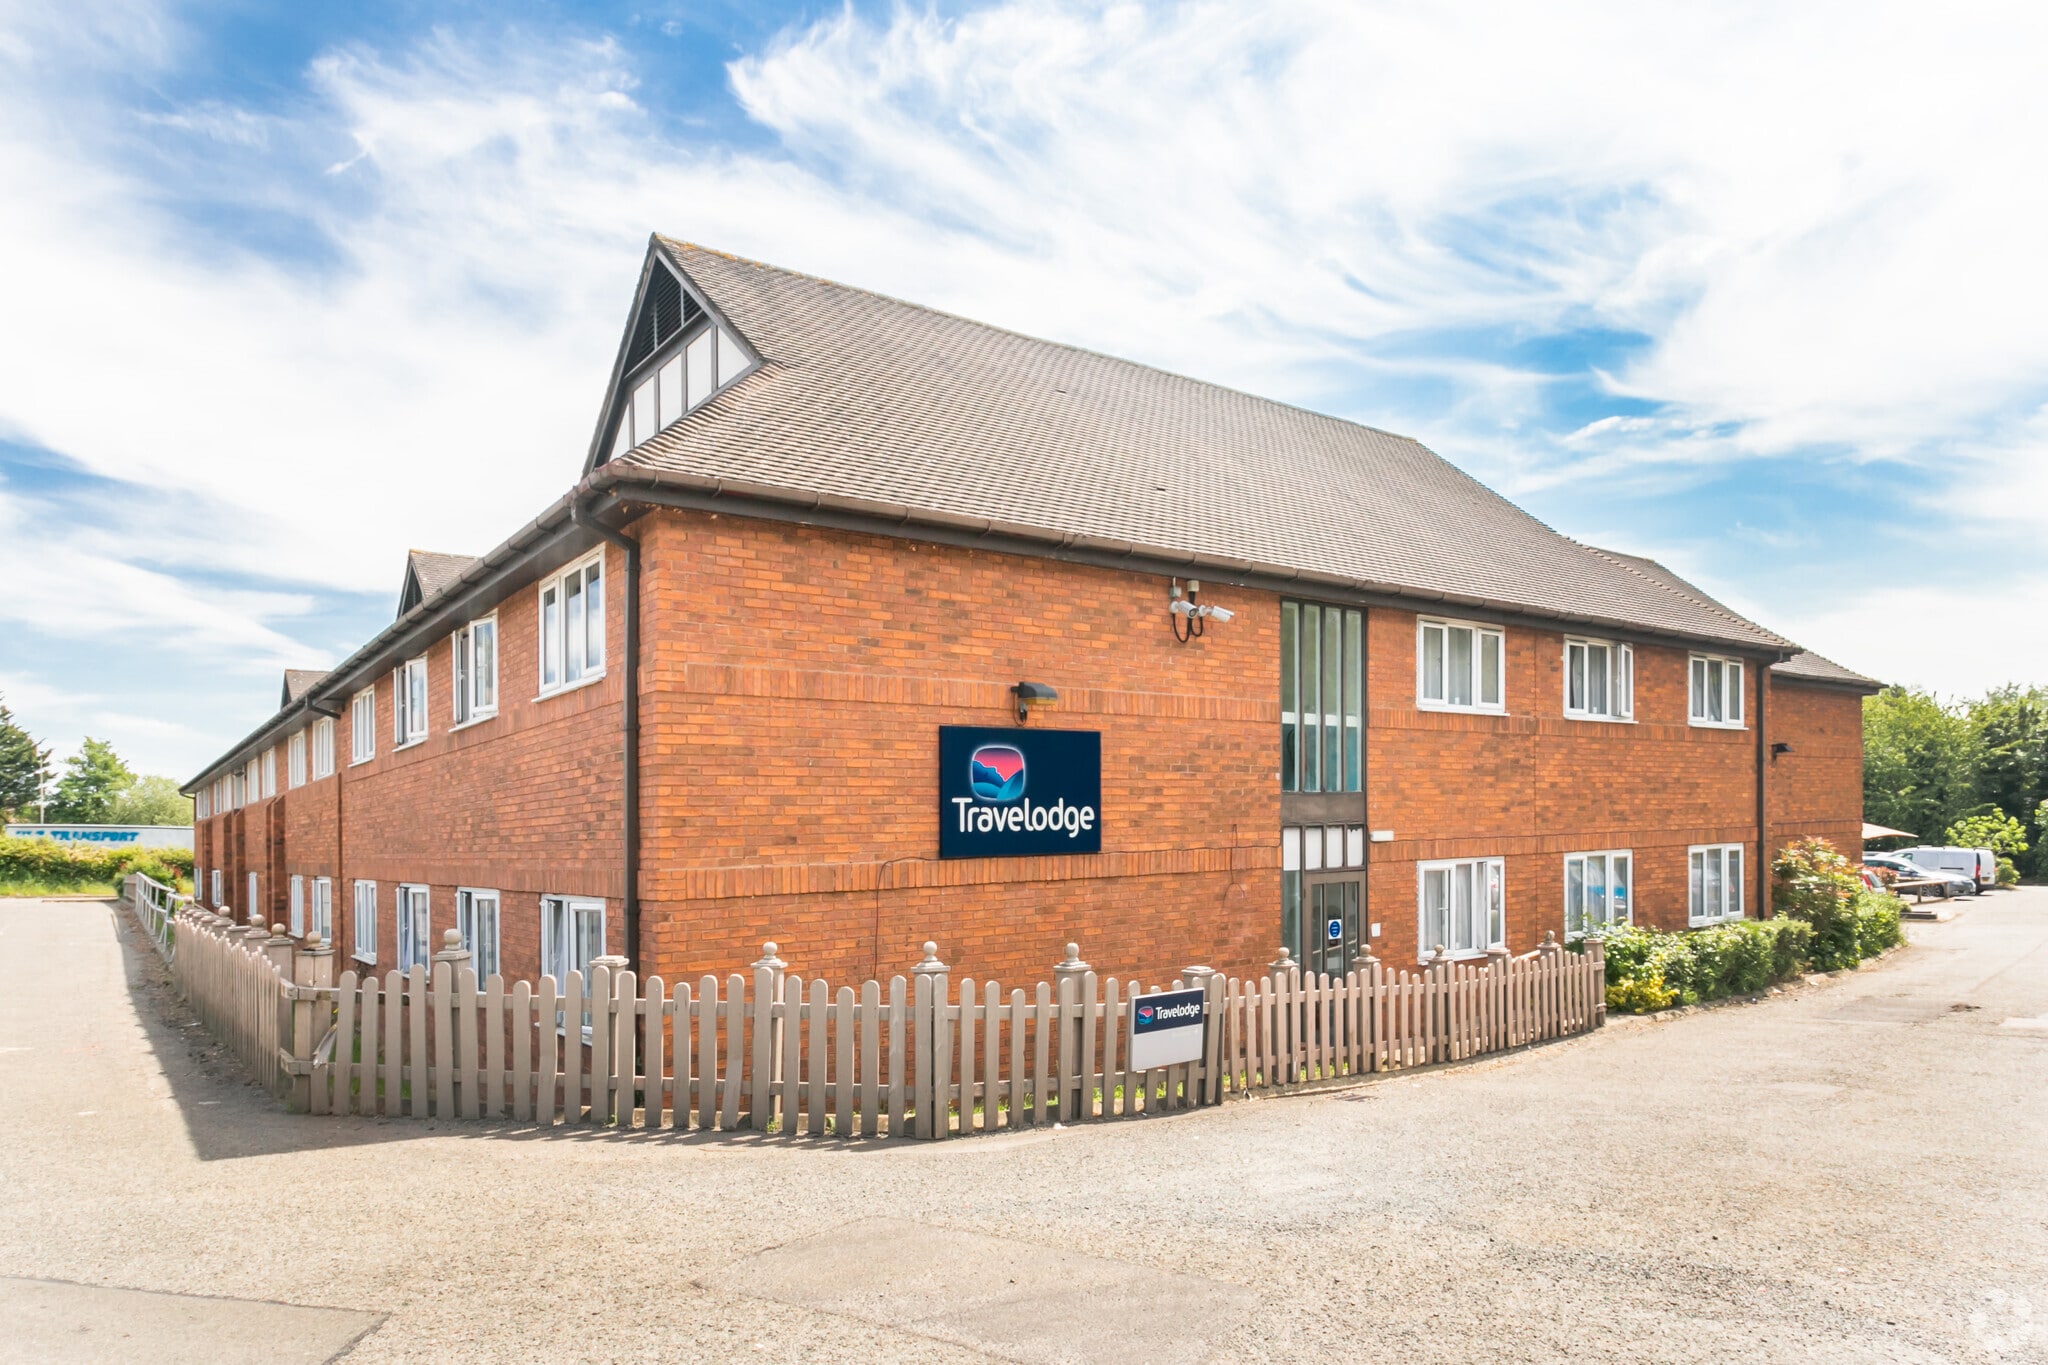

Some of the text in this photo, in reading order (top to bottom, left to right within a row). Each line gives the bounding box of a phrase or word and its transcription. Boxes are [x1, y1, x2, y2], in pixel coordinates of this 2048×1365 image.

[951, 797, 1095, 838] Travelodge
[50, 831, 139, 841] TRANSPORT
[1155, 1002, 1200, 1020] Travelodge
